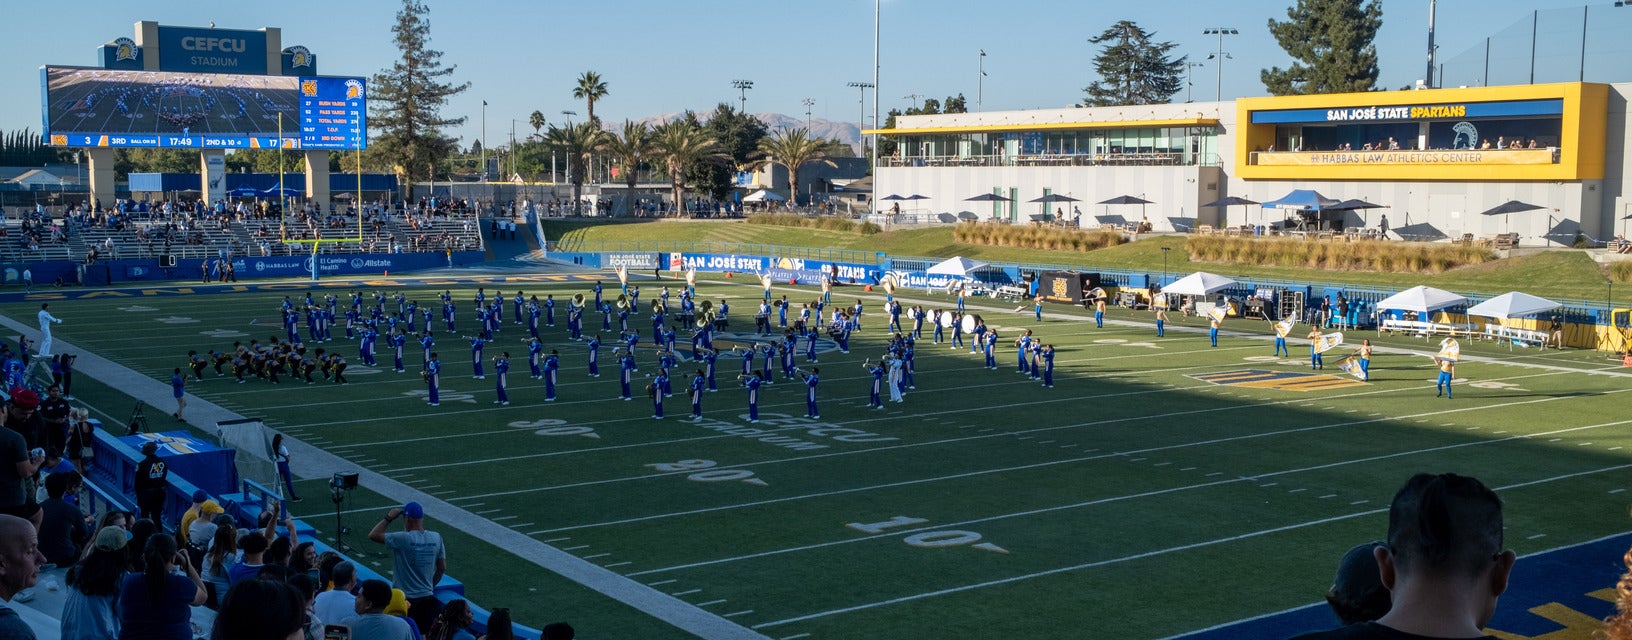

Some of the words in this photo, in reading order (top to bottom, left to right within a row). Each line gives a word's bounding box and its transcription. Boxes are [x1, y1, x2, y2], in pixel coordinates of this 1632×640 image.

[181, 36, 245, 53] CEFCU
[191, 56, 238, 67] STADIUM
[1327, 109, 1348, 121] SAN
[1349, 106, 1376, 120] JOSÉ
[1378, 107, 1408, 119] STATE
[1410, 105, 1466, 118] SPARTANS
[85, 136, 91, 144] 3
[169, 138, 192, 146] 17:49
[1322, 154, 1360, 164] HABBAS
[1362, 154, 1384, 163] LAW
[1387, 153, 1438, 163] ATHLETICS
[1442, 152, 1482, 162] CENTER
[681, 256, 705, 268] SAN
[708, 254, 736, 269] JOSÉ
[738, 258, 762, 270] STATE
[772, 271, 793, 279] PLAYFLY
[821, 264, 866, 280] SPRTANS
[910, 276, 926, 286] SAN
[507, 418, 595, 436] 30
[643, 458, 755, 482] 20
[844, 515, 983, 548] 10
